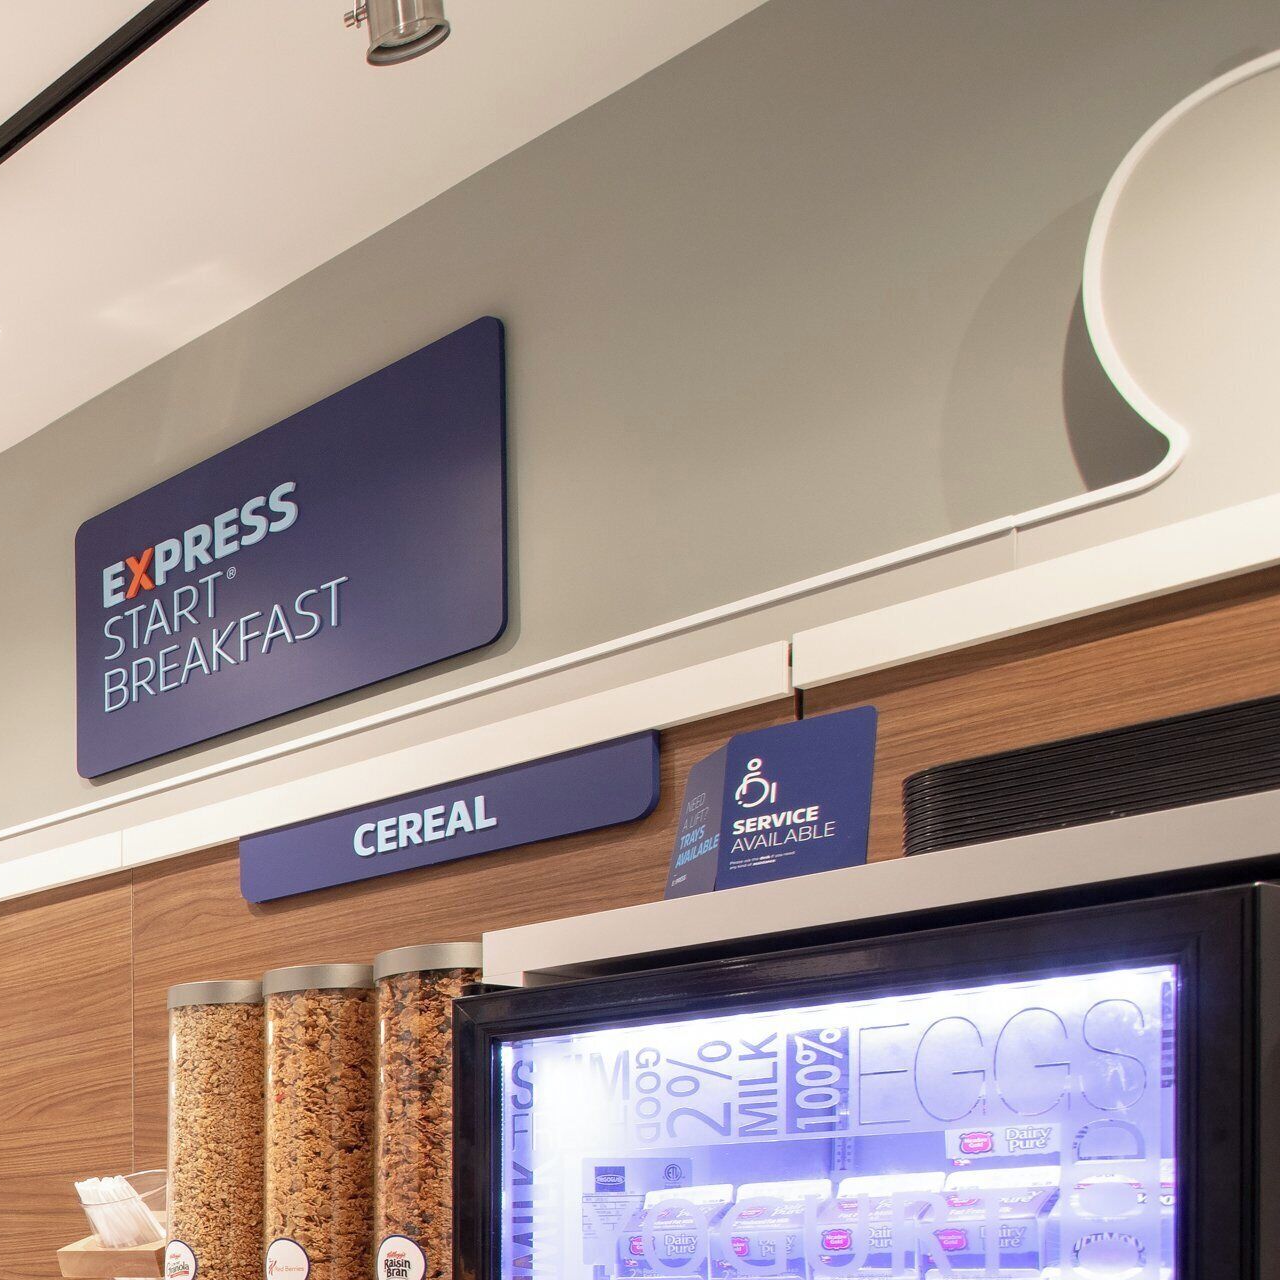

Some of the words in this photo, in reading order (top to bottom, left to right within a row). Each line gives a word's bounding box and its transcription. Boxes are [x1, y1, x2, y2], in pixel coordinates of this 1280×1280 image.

[103, 481, 299, 608] EXPRESS
[104, 576, 349, 713] BREAKFAST
[354, 795, 497, 857] CEREAL
[680, 825, 705, 851] TRAYS
[730, 821, 836, 854] AVAILABLE
[733, 805, 820, 835] SERVICE
[675, 833, 720, 869] AVAILABLE
[796, 1027, 843, 1130] 100%
[858, 998, 1147, 1126] EGGS
[635, 1046, 662, 1143] GOOD
[666, 1040, 733, 1138] 2%
[738, 1031, 778, 1137] MILK
[1006, 1126, 1052, 1140] Dairy
[664, 1234, 698, 1246] Dairy
[868, 1225, 892, 1239] Dair
[384, 1258, 411, 1269] Raisin
[386, 1267, 407, 1278] Bran
